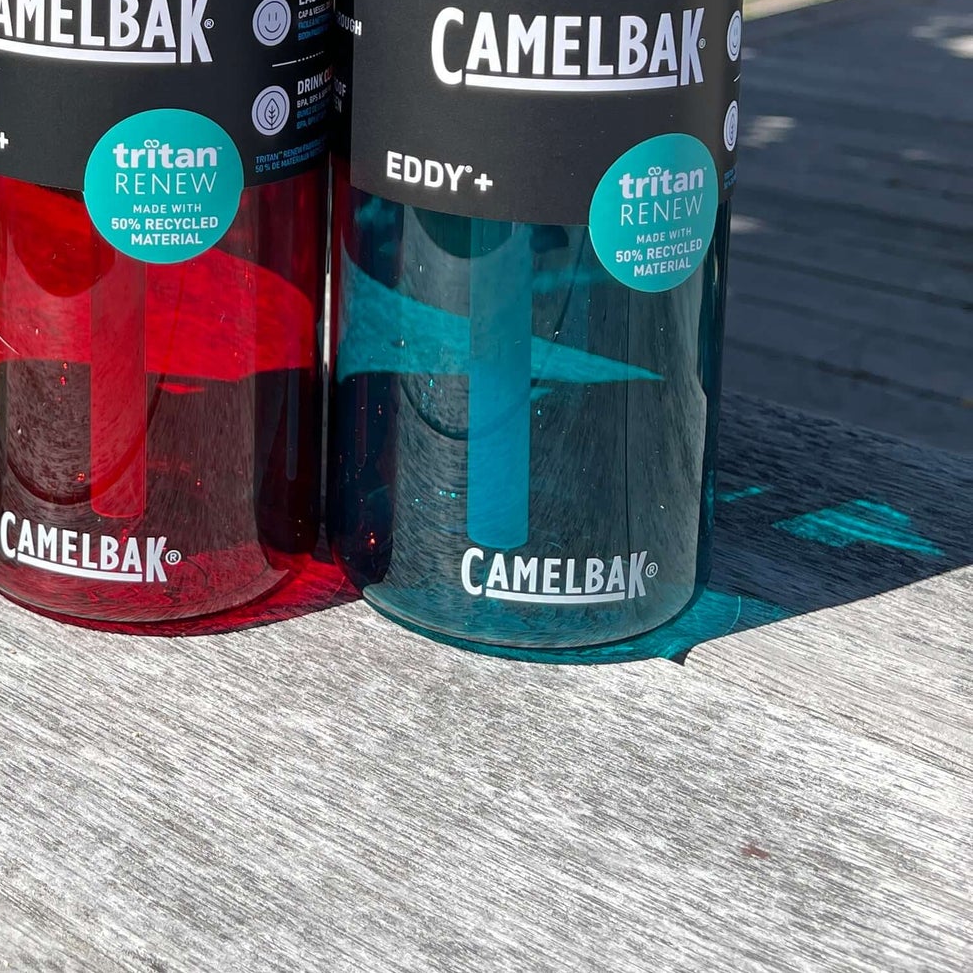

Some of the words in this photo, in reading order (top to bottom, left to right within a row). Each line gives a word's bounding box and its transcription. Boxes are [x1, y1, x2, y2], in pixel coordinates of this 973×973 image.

[297, 71, 324, 95] DRINK
[115, 171, 217, 195] RENEW
[133, 204, 167, 214] MADE
[171, 203, 202, 213] WITH
[620, 193, 703, 226] RENEW
[111, 217, 140, 230] 50%
[145, 216, 218, 230] RECYCLED
[131, 233, 203, 245] MATERIAL
[636, 231, 666, 244] MADE
[669, 227, 692, 240] WITH
[615, 249, 643, 262] 50%
[647, 238, 703, 260] RECYCLED
[633, 257, 691, 277] MATERIAL
